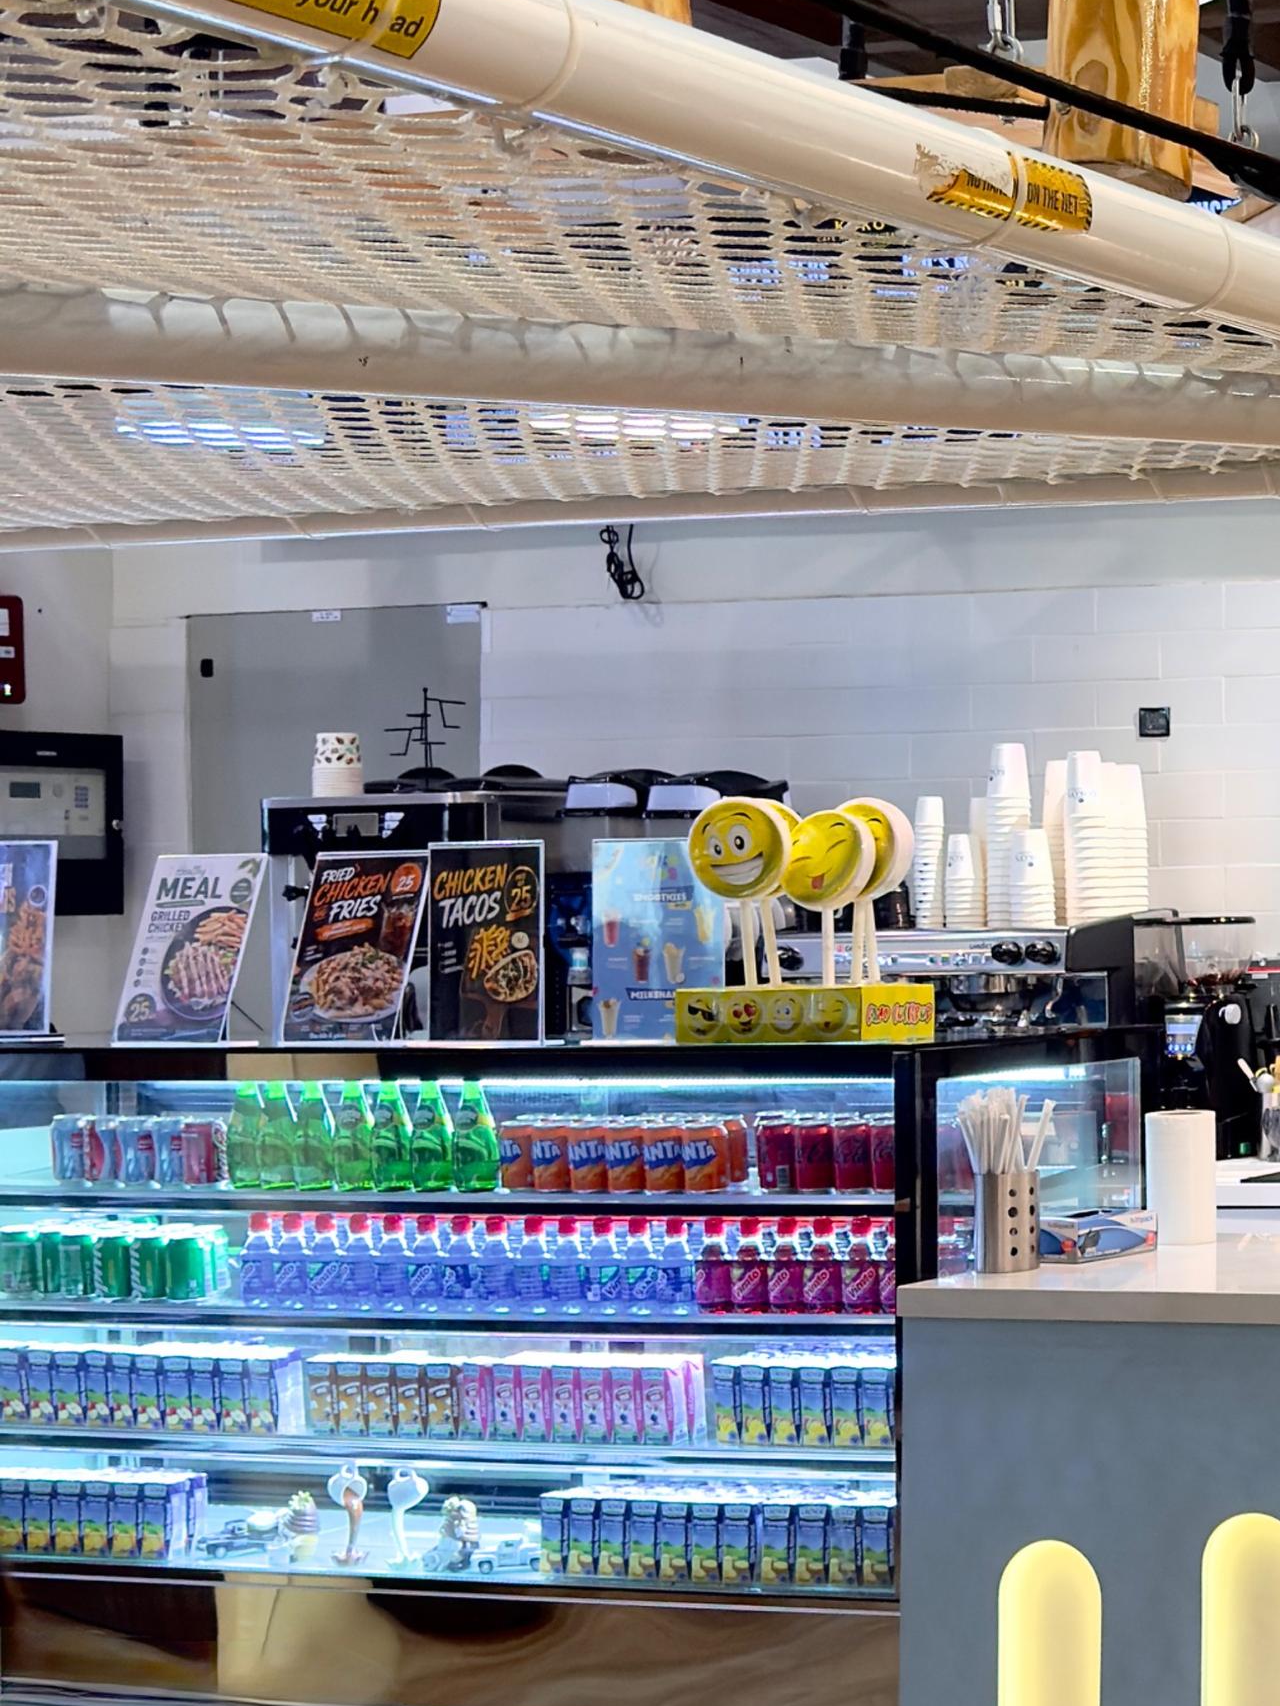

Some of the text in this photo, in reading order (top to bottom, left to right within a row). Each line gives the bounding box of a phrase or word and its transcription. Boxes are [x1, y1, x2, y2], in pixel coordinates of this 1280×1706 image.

[1041, 184, 1059, 211] THE
[1060, 191, 1078, 215] NET
[156, 876, 223, 901] MEAL
[313, 871, 393, 907] CHICKEN
[320, 867, 356, 885] FRIED
[433, 863, 508, 901] CHICKEN
[328, 895, 382, 924] FRIES
[437, 890, 502, 929] TACOS
[511, 884, 533, 910] 25
[150, 910, 191, 923] GRILLED
